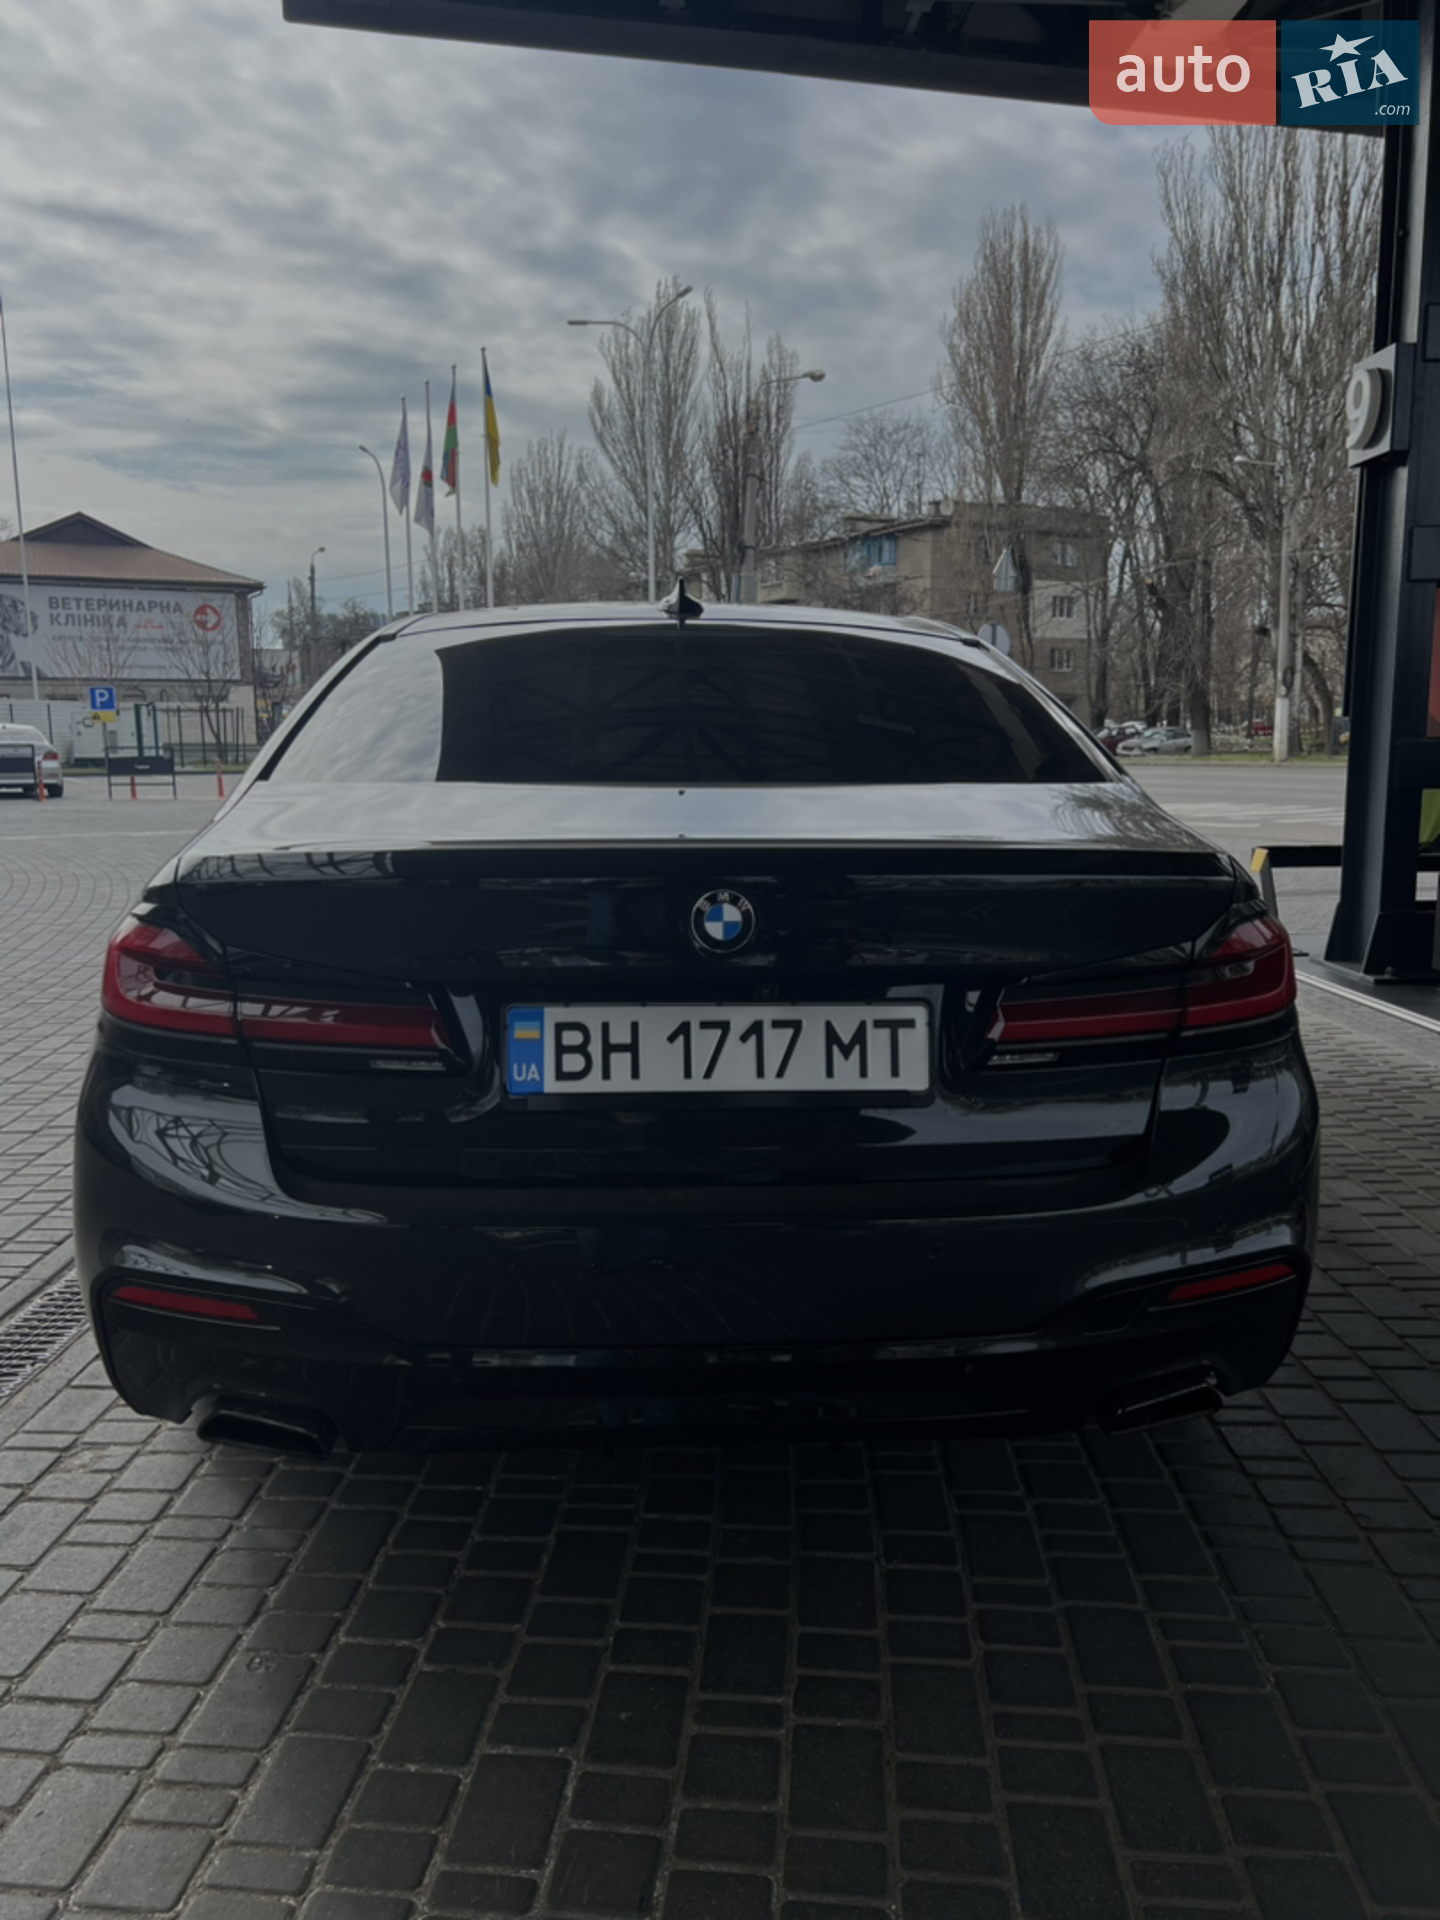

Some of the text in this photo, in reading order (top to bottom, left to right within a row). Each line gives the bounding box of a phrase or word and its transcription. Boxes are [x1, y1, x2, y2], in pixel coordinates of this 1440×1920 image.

[1345, 368, 1379, 450] 9
[48, 596, 184, 614] ВЕТЕРИНАРНА
[50, 613, 127, 628] КЛІНІКА
[95, 689, 109, 708] P
[555, 1018, 916, 1081] BH 1717 MT
[513, 1063, 541, 1082] UA
